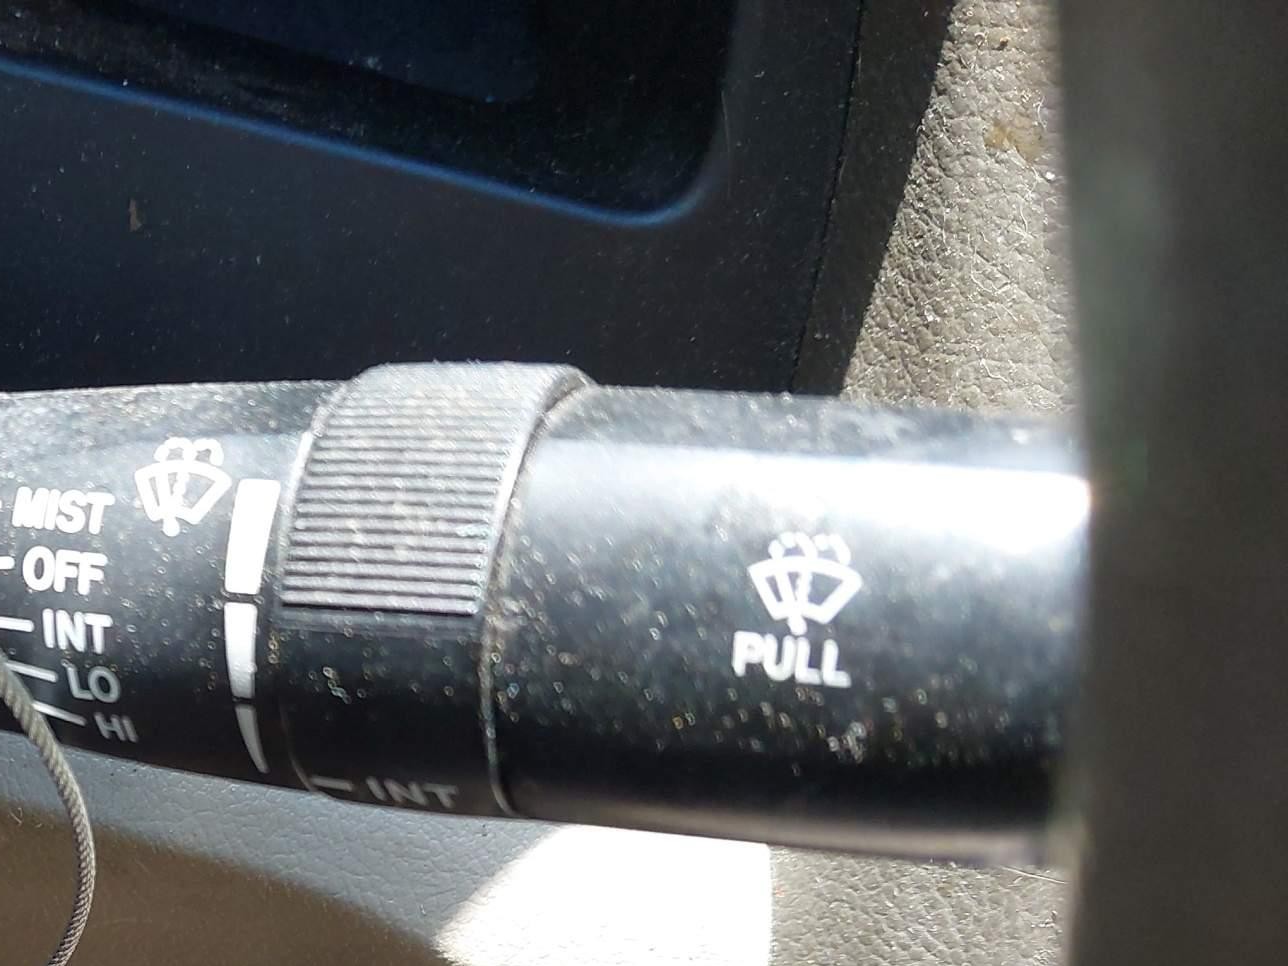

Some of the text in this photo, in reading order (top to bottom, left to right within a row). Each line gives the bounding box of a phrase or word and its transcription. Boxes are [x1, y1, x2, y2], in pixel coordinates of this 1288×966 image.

[12, 486, 115, 534] MIST
[22, 545, 108, 596] OFF
[42, 608, 112, 654] INT
[731, 630, 851, 688] PULL
[65, 664, 121, 703] LO
[95, 711, 138, 742] HI
[365, 775, 459, 809] INT
